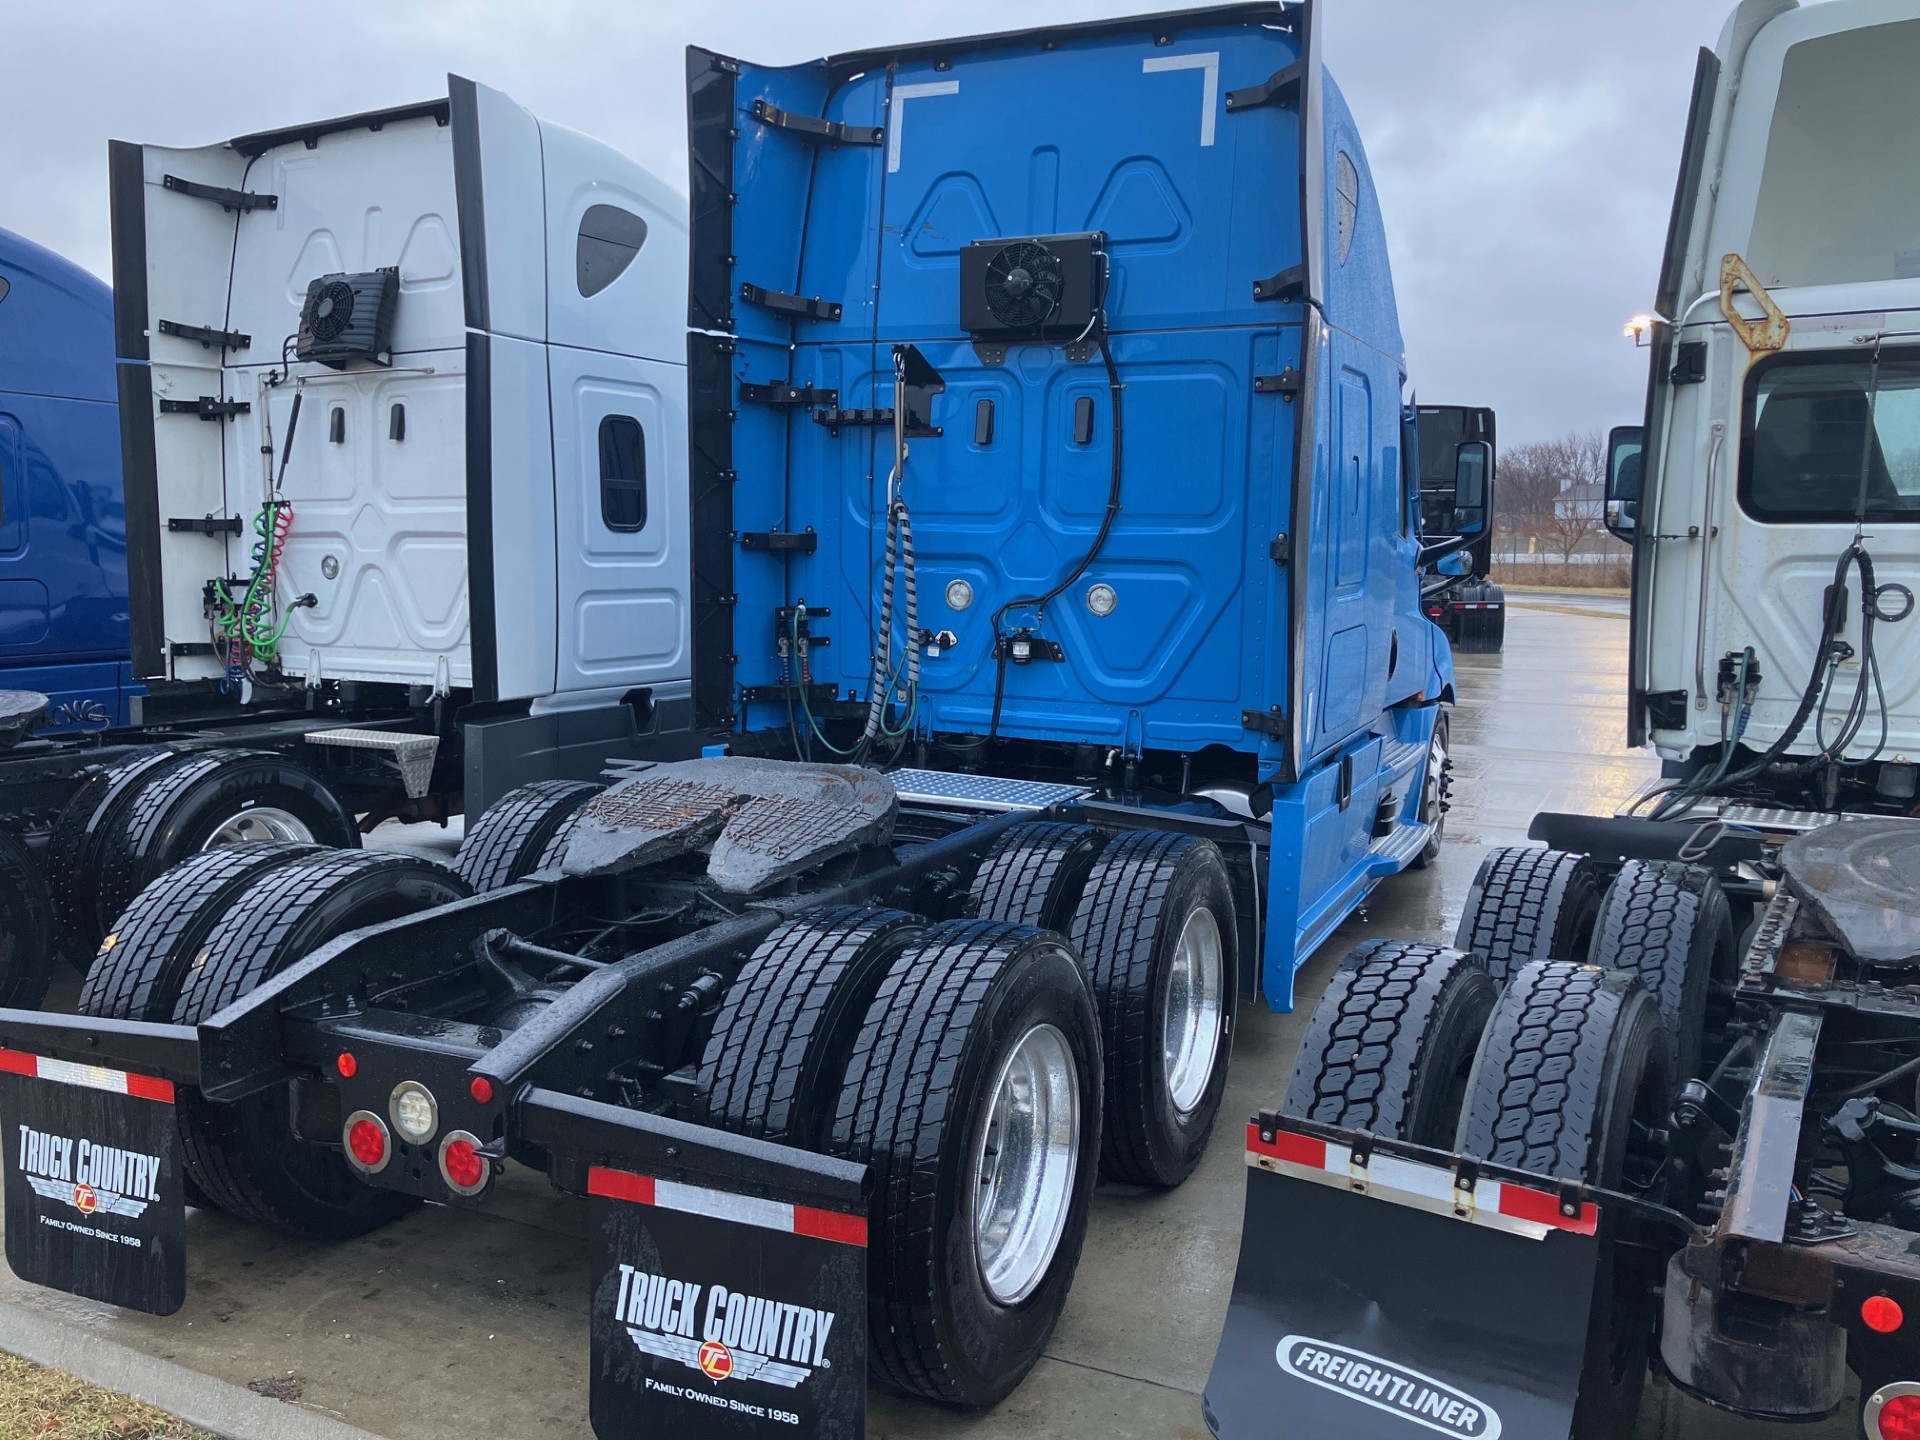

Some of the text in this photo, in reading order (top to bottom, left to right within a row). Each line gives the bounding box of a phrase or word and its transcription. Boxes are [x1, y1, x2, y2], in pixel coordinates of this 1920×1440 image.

[19, 1124, 160, 1201] TRUCK COUNTRY
[40, 1215, 141, 1247] FAMILY OWNED SINCE 1958
[615, 1263, 835, 1368] TRUCK COUNTRY
[645, 1377, 799, 1425] FAMILY OWNED SINCE 1958
[1295, 1347, 1479, 1431] FREIGHTLINER
